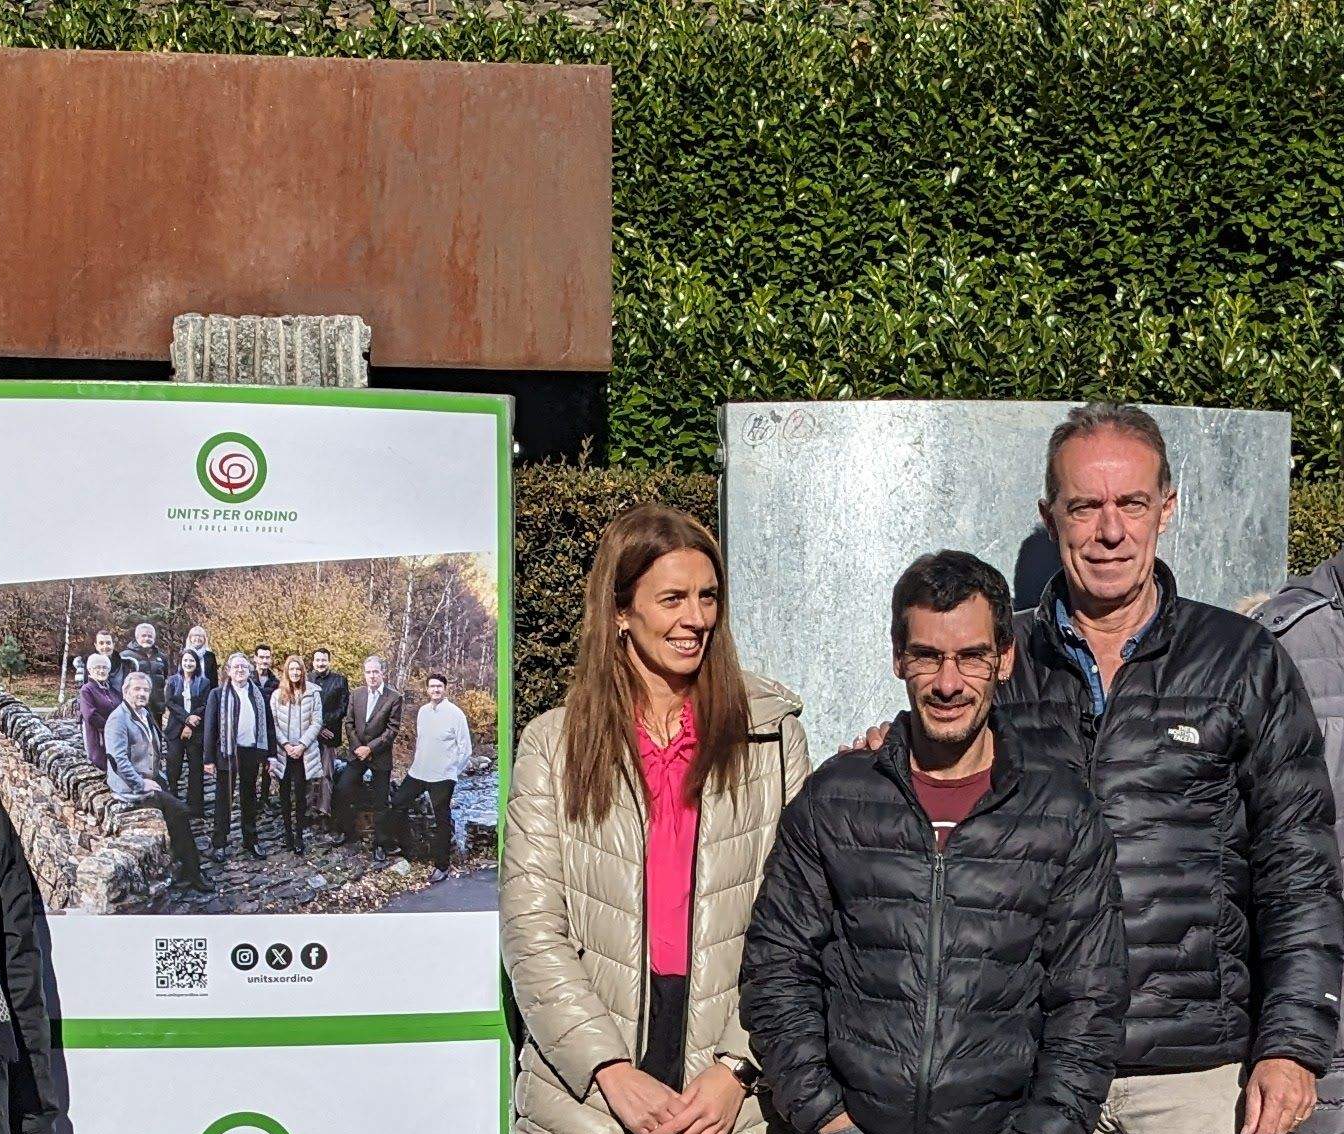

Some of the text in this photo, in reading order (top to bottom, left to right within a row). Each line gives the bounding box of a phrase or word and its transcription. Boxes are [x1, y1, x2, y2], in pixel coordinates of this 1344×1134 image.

[167, 508, 298, 522] UNITS PER ORDINO
[247, 974, 314, 984] unitsxordino
